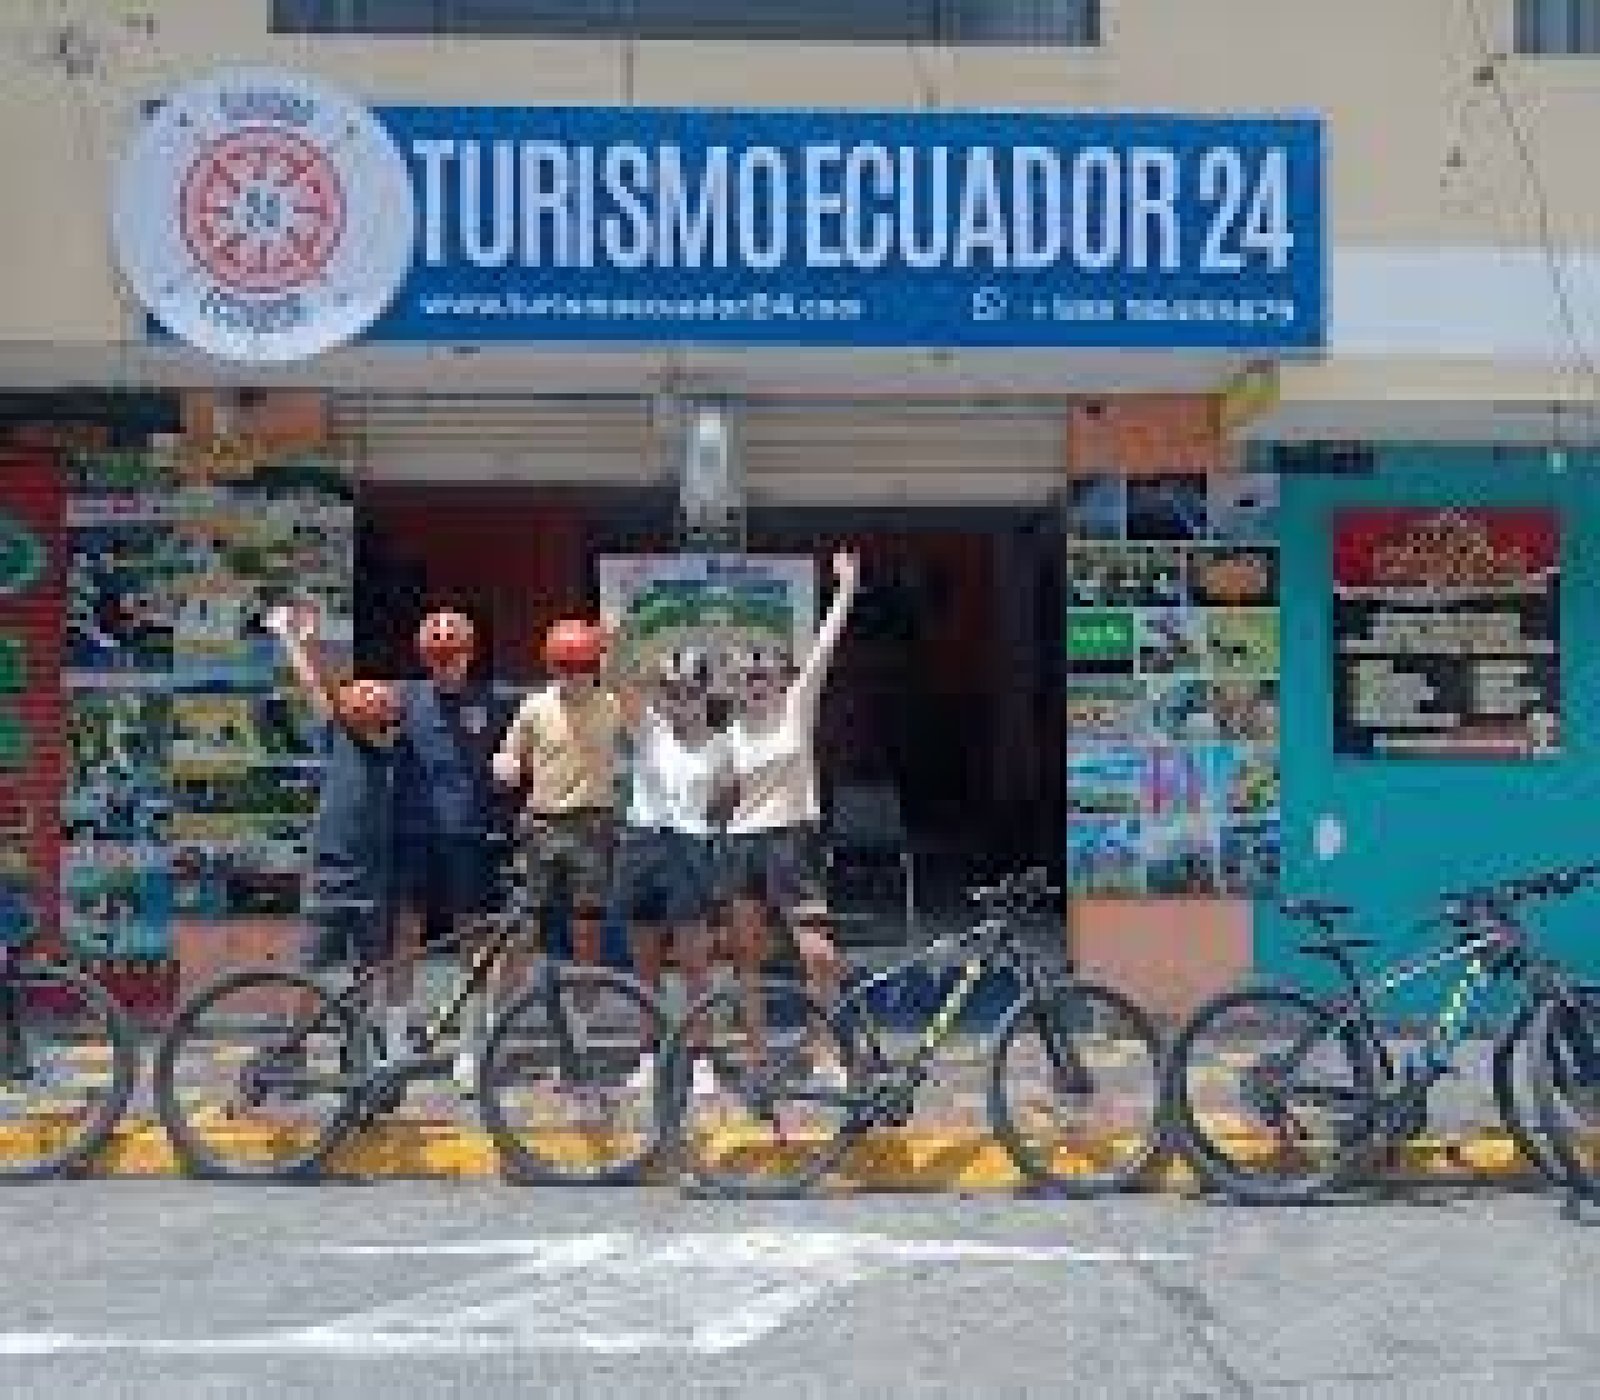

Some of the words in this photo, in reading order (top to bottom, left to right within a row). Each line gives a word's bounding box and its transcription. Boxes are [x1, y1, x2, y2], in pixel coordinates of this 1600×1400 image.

[413, 139, 787, 268] TURISMO
[805, 142, 1181, 271] ECUADOR
[1199, 146, 1294, 272] 24
